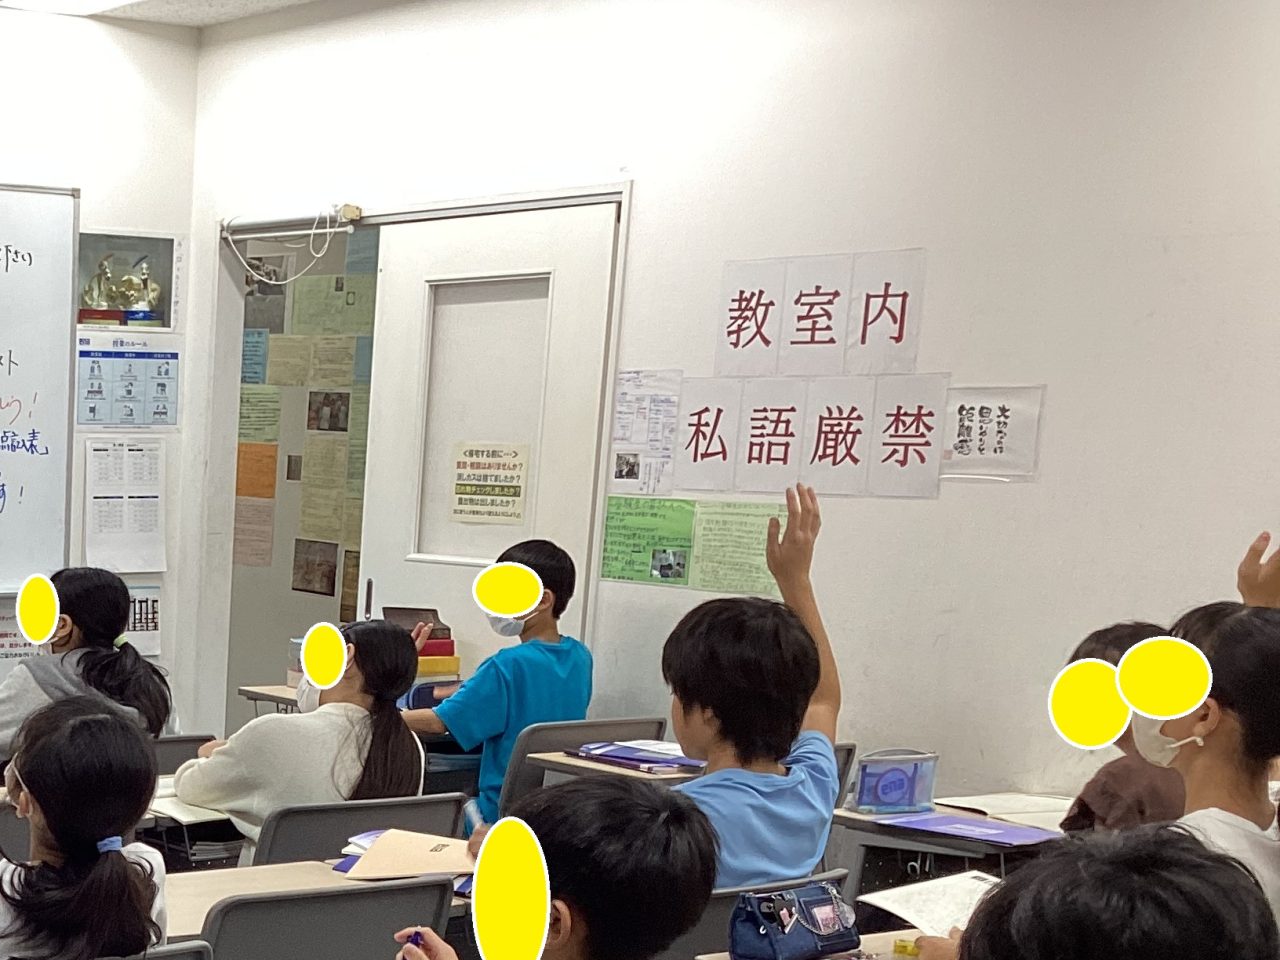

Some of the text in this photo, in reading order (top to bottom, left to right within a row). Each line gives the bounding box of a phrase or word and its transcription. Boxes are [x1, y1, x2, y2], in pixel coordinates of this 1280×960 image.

[726, 282, 910, 350] 教室内
[684, 404, 935, 467] 私語厳禁
[881, 778, 905, 796] ena
